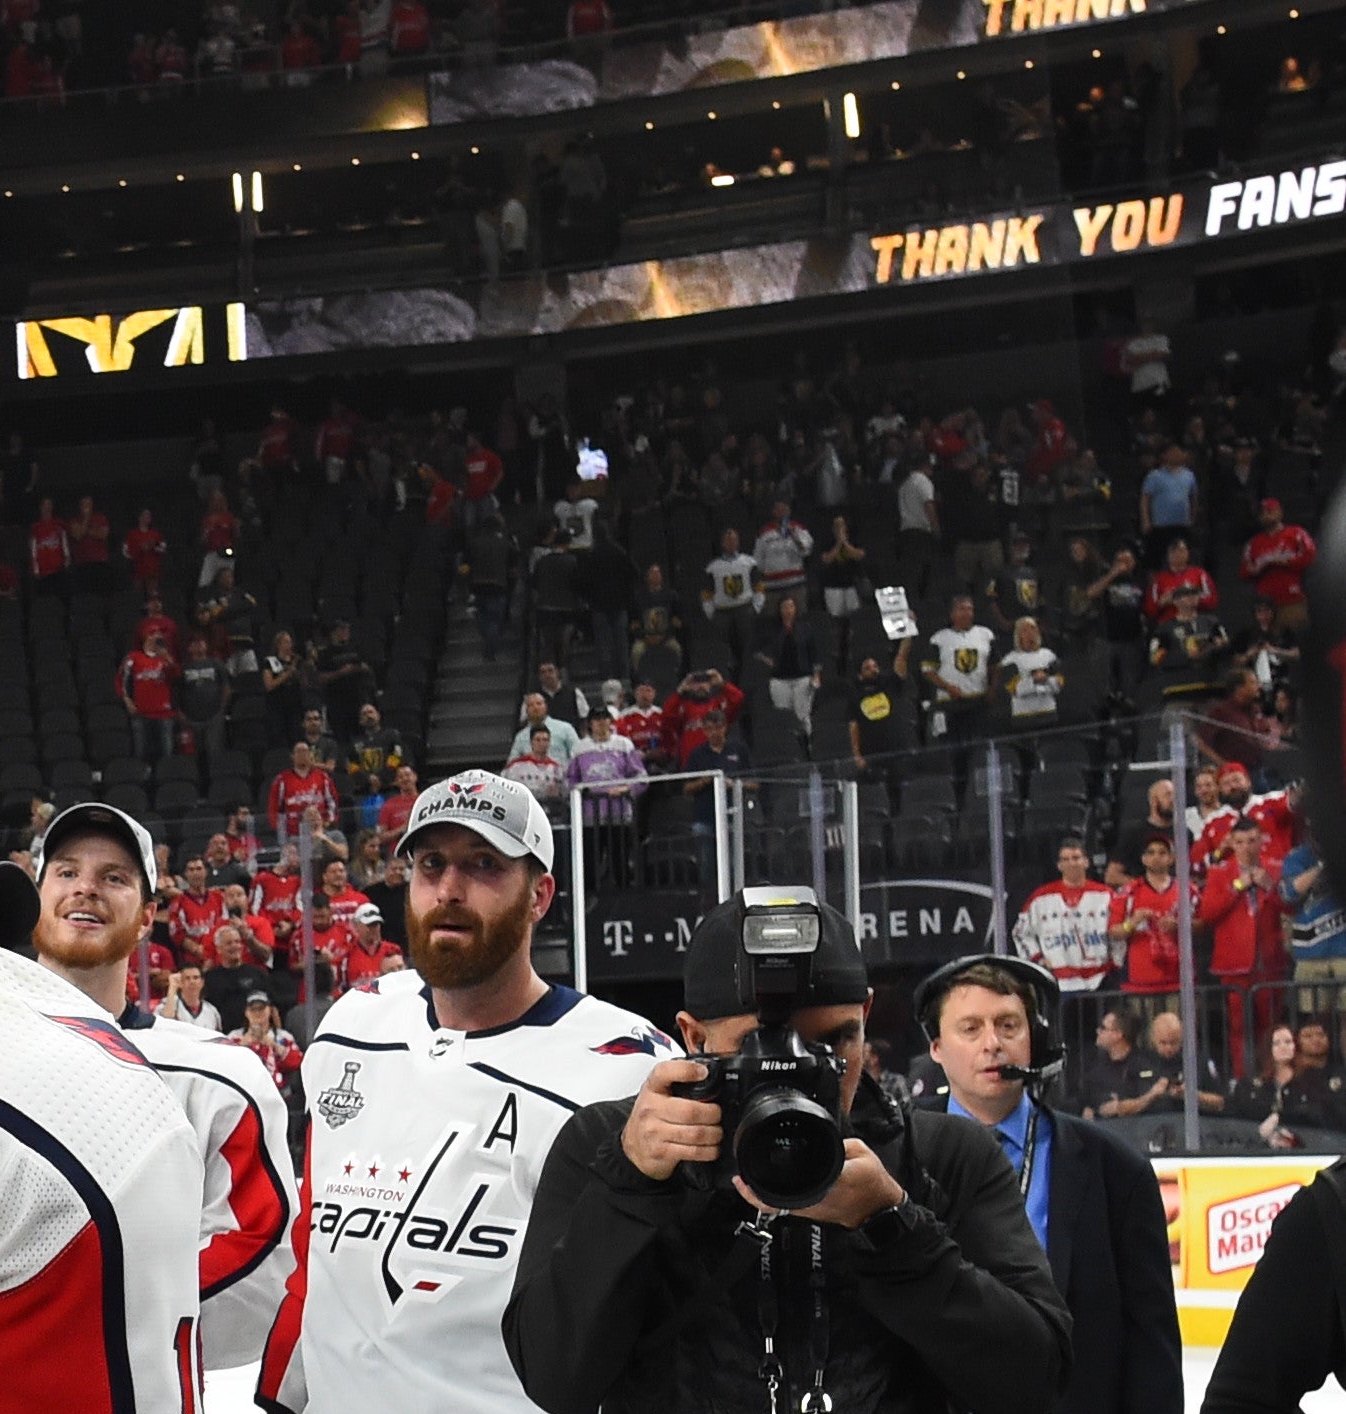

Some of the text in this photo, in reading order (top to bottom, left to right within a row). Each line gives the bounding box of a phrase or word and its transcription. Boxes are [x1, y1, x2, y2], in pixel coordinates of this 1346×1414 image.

[871, 160, 1346, 284] THANK YOU FANS
[417, 796, 507, 822] CHAMPS
[860, 905, 976, 940] RENA
[760, 1060, 798, 1071] Nikon
[317, 1092, 365, 1109] FINAL
[482, 1092, 518, 1155] A
[325, 1183, 405, 1202] WASHINGTON
